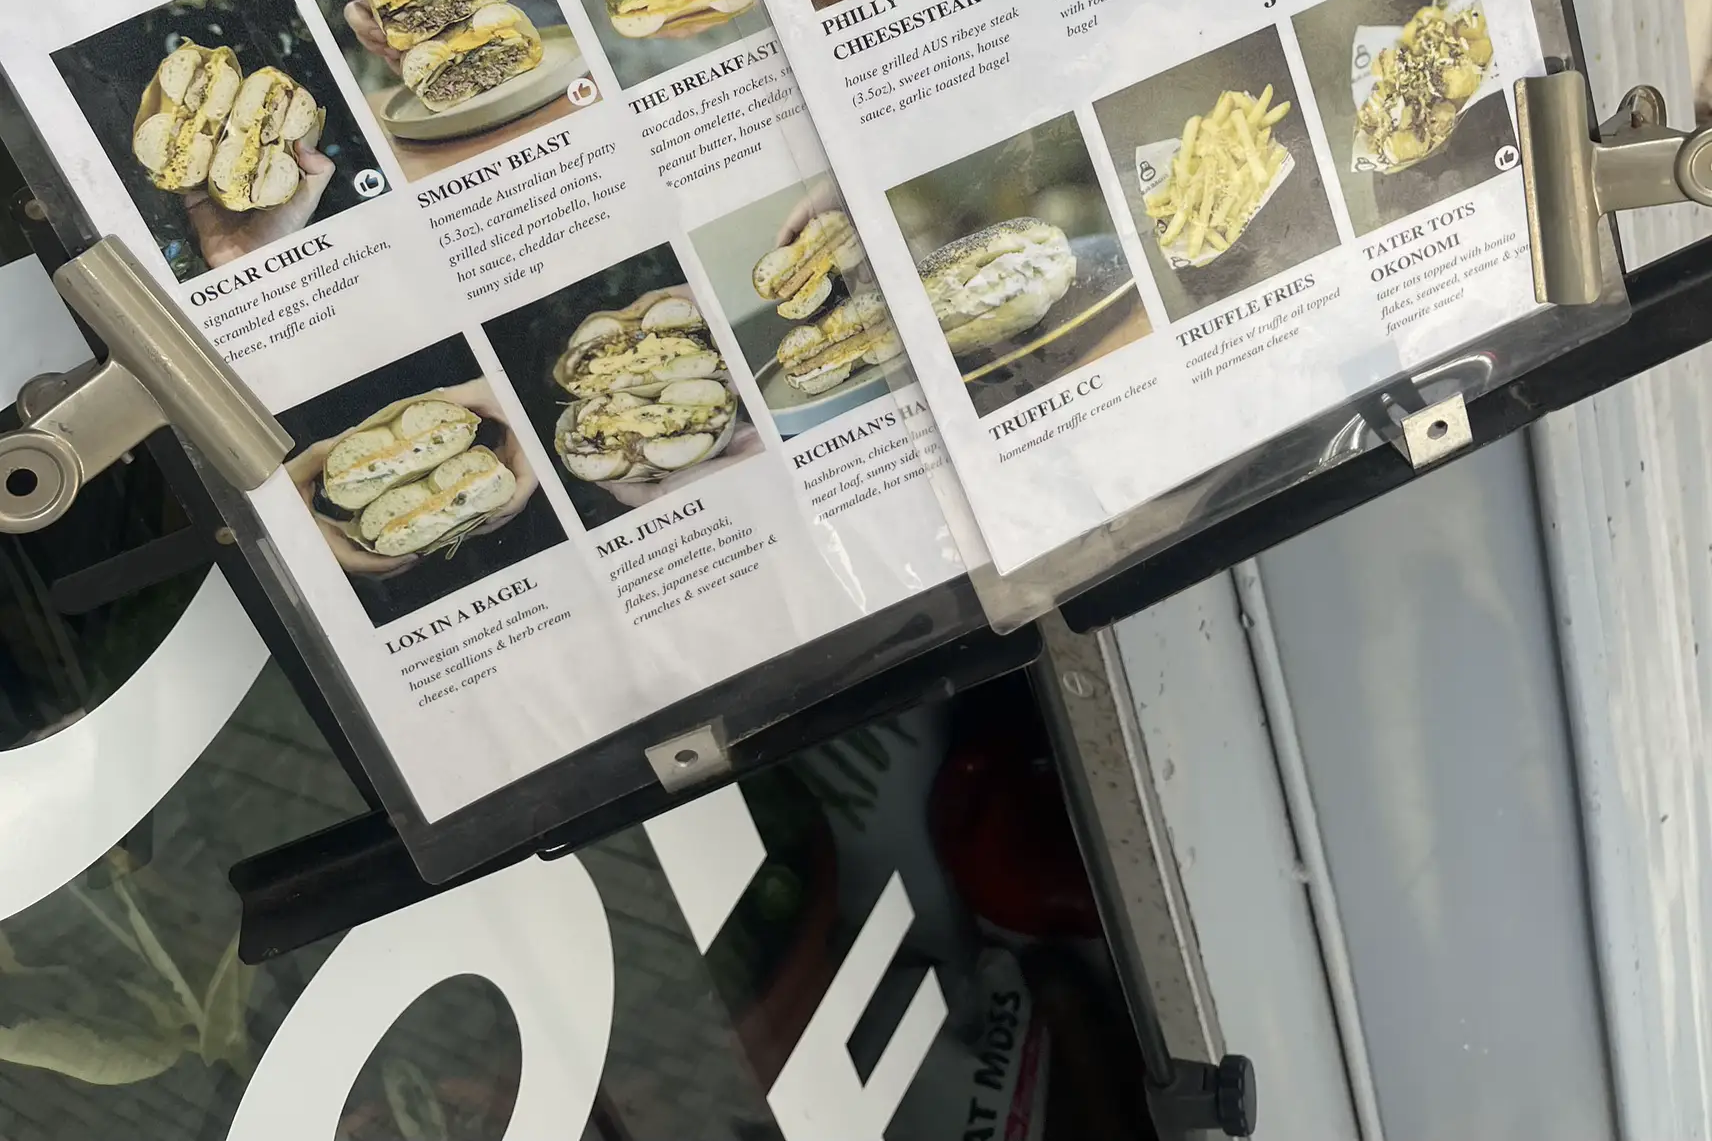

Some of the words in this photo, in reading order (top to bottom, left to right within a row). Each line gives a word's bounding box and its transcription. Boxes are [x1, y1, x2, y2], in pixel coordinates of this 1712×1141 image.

[1060, 0, 1085, 18] with
[1066, 14, 1097, 37] bagel
[628, 88, 669, 114] THE
[670, 39, 778, 97] BREAKFAST
[844, 68, 877, 88] house
[881, 47, 919, 75] grilled
[922, 35, 948, 56] AUS
[951, 22, 986, 43] ribeye
[990, 6, 1019, 27] steak
[899, 66, 930, 87] sweet
[933, 50, 974, 72] onions,
[976, 34, 1009, 53] house
[642, 109, 698, 138] avocados,
[701, 90, 730, 114] fresh
[733, 74, 777, 97] rockets,
[860, 104, 895, 124] sauce,
[899, 87, 931, 110] garlic
[935, 65, 975, 92] toasted
[978, 51, 1009, 74] bagel
[650, 131, 691, 156] salmon
[694, 109, 745, 136] omelette,
[748, 87, 792, 112] cheddar
[658, 149, 696, 177] peanut
[698, 134, 737, 155] butter,
[738, 117, 772, 137] house
[723, 142, 761, 168] peanut
[417, 160, 502, 209] SMOKIN'
[506, 130, 570, 170] BEAST
[429, 196, 492, 229] homemade
[496, 168, 557, 202] Australian
[558, 152, 584, 173] beef
[587, 142, 615, 164] patty
[486, 186, 557, 227] caramelised
[560, 171, 602, 194] onions,
[449, 239, 487, 267] grilled
[490, 223, 524, 248] sliced
[527, 198, 590, 234] portobello,
[592, 181, 626, 202] house
[456, 268, 476, 283] hot
[479, 254, 515, 274] sauce,
[518, 229, 565, 257] cheddar
[568, 211, 610, 234] cheese,
[1362, 225, 1424, 260] TATER
[1427, 201, 1475, 231] TOTS
[1370, 233, 1460, 282] OKONOMI
[190, 267, 262, 306] OSCAR
[264, 233, 333, 273] CHICK
[203, 298, 258, 329] signature
[261, 280, 296, 302] house
[300, 258, 339, 287] grilled
[342, 241, 391, 266] chicken,
[466, 280, 499, 300] sunny
[503, 268, 526, 285] side
[529, 261, 544, 274] up
[1376, 285, 1399, 301] tater
[1403, 275, 1421, 289] tots
[1423, 256, 1457, 279] topped
[1459, 246, 1481, 262] with
[1484, 232, 1516, 252] bonito
[213, 309, 275, 346] scrambled
[278, 299, 309, 317] eggs,
[312, 275, 359, 302] cheddar
[269, 321, 304, 344] truffle
[308, 305, 336, 326] aioli
[1175, 299, 1260, 346] TRUFFLE
[1263, 273, 1315, 307] FRIES
[1185, 344, 1219, 368] coated
[1221, 335, 1243, 354] fries
[1258, 314, 1288, 334] truffle
[1290, 303, 1304, 318] oil
[1306, 286, 1340, 311] topped
[1191, 367, 1213, 384] with
[1215, 344, 1264, 375] parmesan
[1266, 327, 1299, 348] cheese
[792, 412, 896, 469] RICHMAN'S
[988, 389, 1074, 440] TRUFFLE
[1076, 374, 1102, 396] CC
[999, 429, 1054, 463] homemade
[1057, 412, 1087, 434] truffle
[1090, 395, 1122, 416] cream
[1124, 377, 1157, 398] cheese
[803, 457, 865, 490] hashbrown,
[868, 436, 908, 459] chicken
[811, 487, 837, 506] meat
[839, 473, 863, 492] loaf,
[866, 460, 896, 478] sunny
[596, 535, 633, 558] MR.
[636, 499, 704, 541] JUNAGI
[819, 485, 881, 521] marmalade,
[884, 477, 900, 491] hot
[609, 553, 645, 581] grilled
[647, 538, 678, 561] unagi
[680, 516, 732, 545] kabayaki,
[617, 567, 664, 598] japanese
[667, 545, 715, 570] omelette,
[717, 527, 752, 547] bonito
[625, 590, 660, 614] flakes,
[662, 565, 708, 595] japanese
[712, 541, 764, 569] cucumber
[767, 534, 777, 545] &
[385, 627, 428, 654] LOX
[429, 615, 452, 635] IN
[458, 609, 470, 623] A
[471, 577, 537, 614] BAGEL
[633, 597, 681, 625] crunches
[684, 589, 693, 601] &
[697, 575, 726, 595] sweet
[729, 562, 759, 580] sauce
[400, 644, 460, 676] norwegian
[506, 603, 548, 626] salmon,
[408, 671, 441, 691] house
[444, 649, 493, 675] scallions
[496, 639, 507, 651] &
[508, 626, 534, 644] herb
[537, 610, 571, 631] cream
[418, 685, 458, 707] cheese,
[461, 665, 497, 687] capers
[974, 991, 1020, 1092] MOSS
